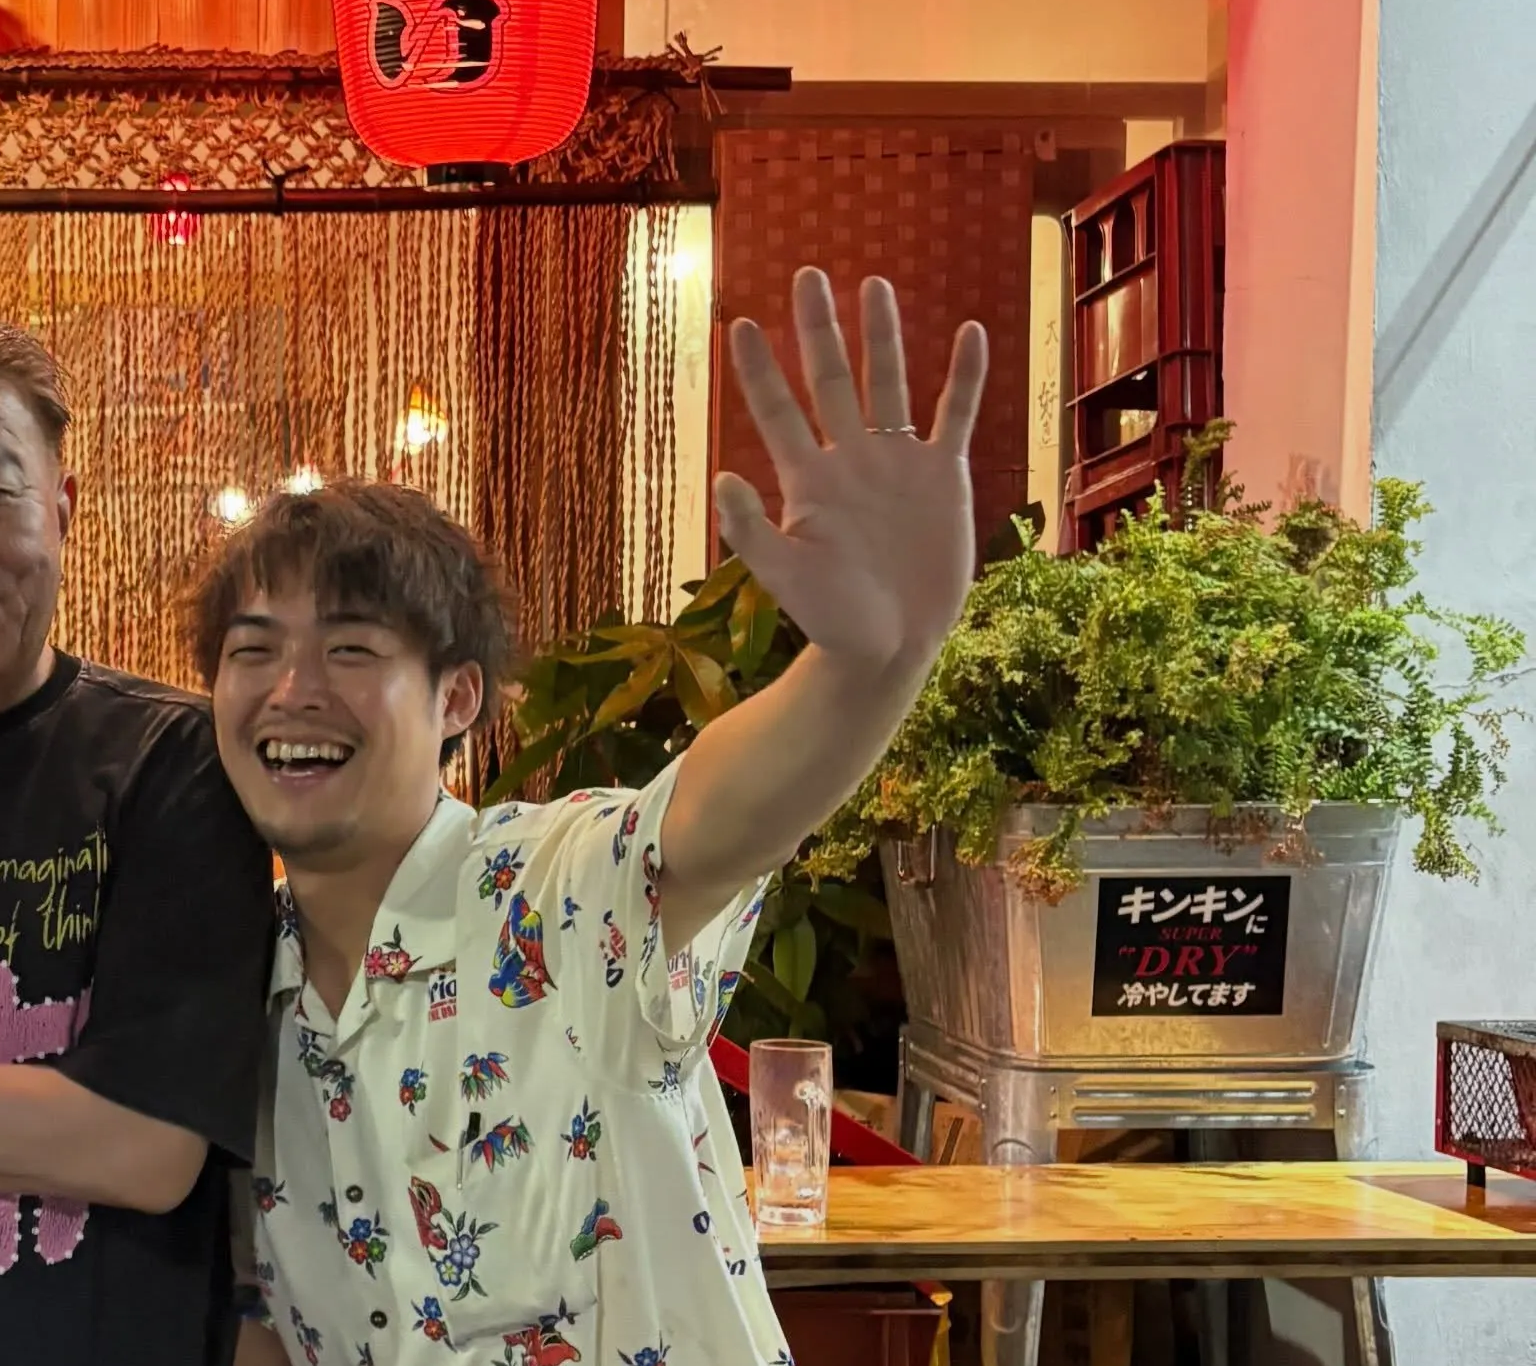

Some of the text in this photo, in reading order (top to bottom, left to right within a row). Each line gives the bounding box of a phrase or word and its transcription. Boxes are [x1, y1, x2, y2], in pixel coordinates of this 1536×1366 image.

[1117, 885, 1269, 935] キンキンに
[1159, 926, 1223, 941] SUPER
[1117, 982, 1257, 1008] 冷やしてます
